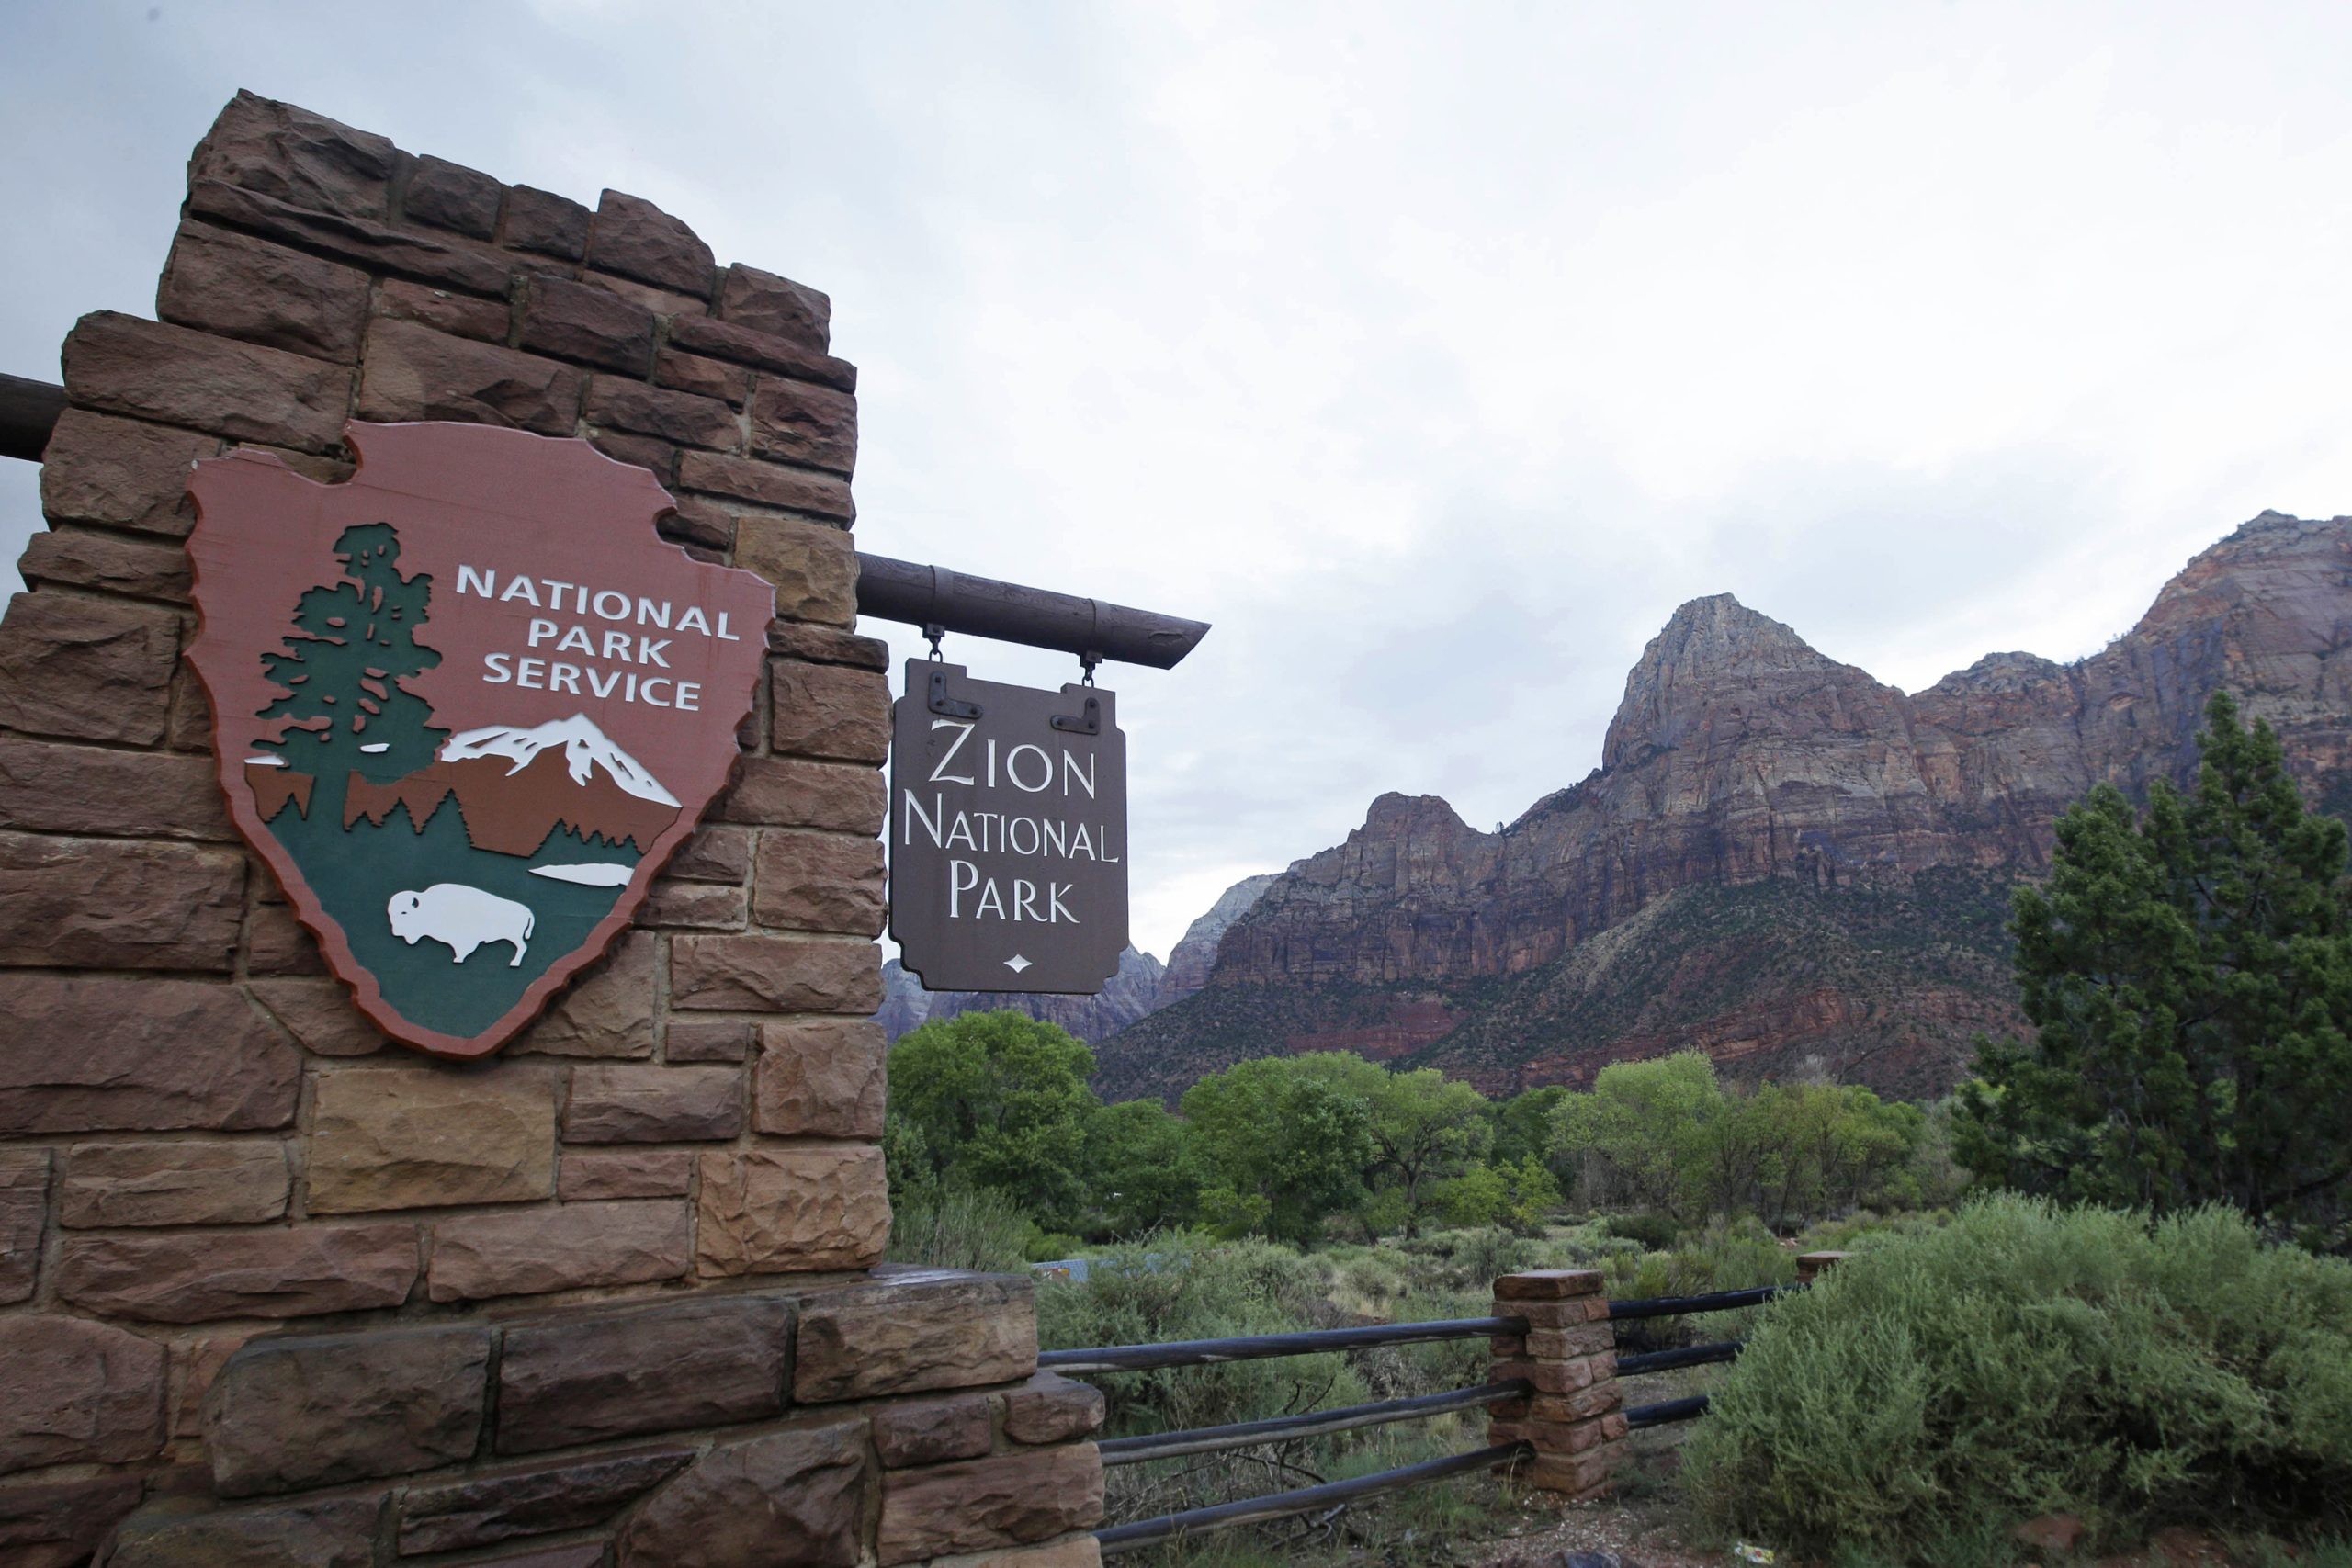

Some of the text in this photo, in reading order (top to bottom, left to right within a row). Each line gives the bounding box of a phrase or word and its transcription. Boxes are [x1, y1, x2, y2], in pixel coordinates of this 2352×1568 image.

[456, 564, 741, 641] NATIONAL
[527, 618, 673, 669] PARK
[482, 652, 702, 712] SERVICE
[928, 719, 1096, 800] ZION
[903, 788, 1120, 863] NATIONAL
[949, 859, 1081, 924] PARK
